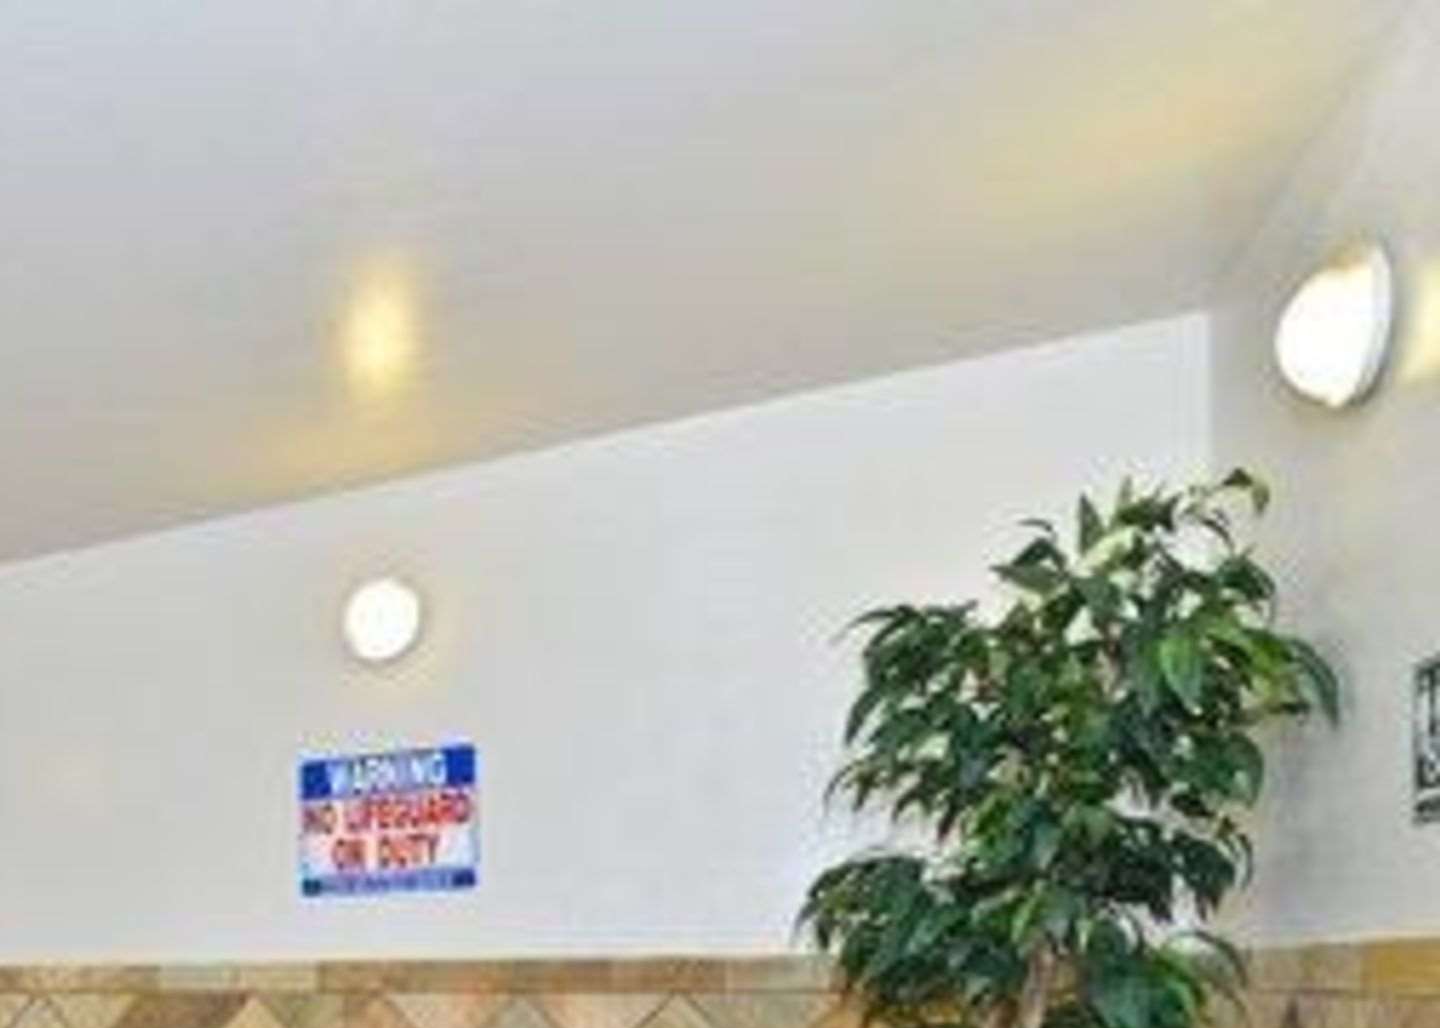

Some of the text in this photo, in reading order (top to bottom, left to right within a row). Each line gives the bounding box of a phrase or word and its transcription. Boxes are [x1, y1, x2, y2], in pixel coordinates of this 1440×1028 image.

[325, 754, 446, 794] WARNING
[303, 793, 471, 834] NO LIFEGUARD
[331, 834, 440, 870] ON DUTY
